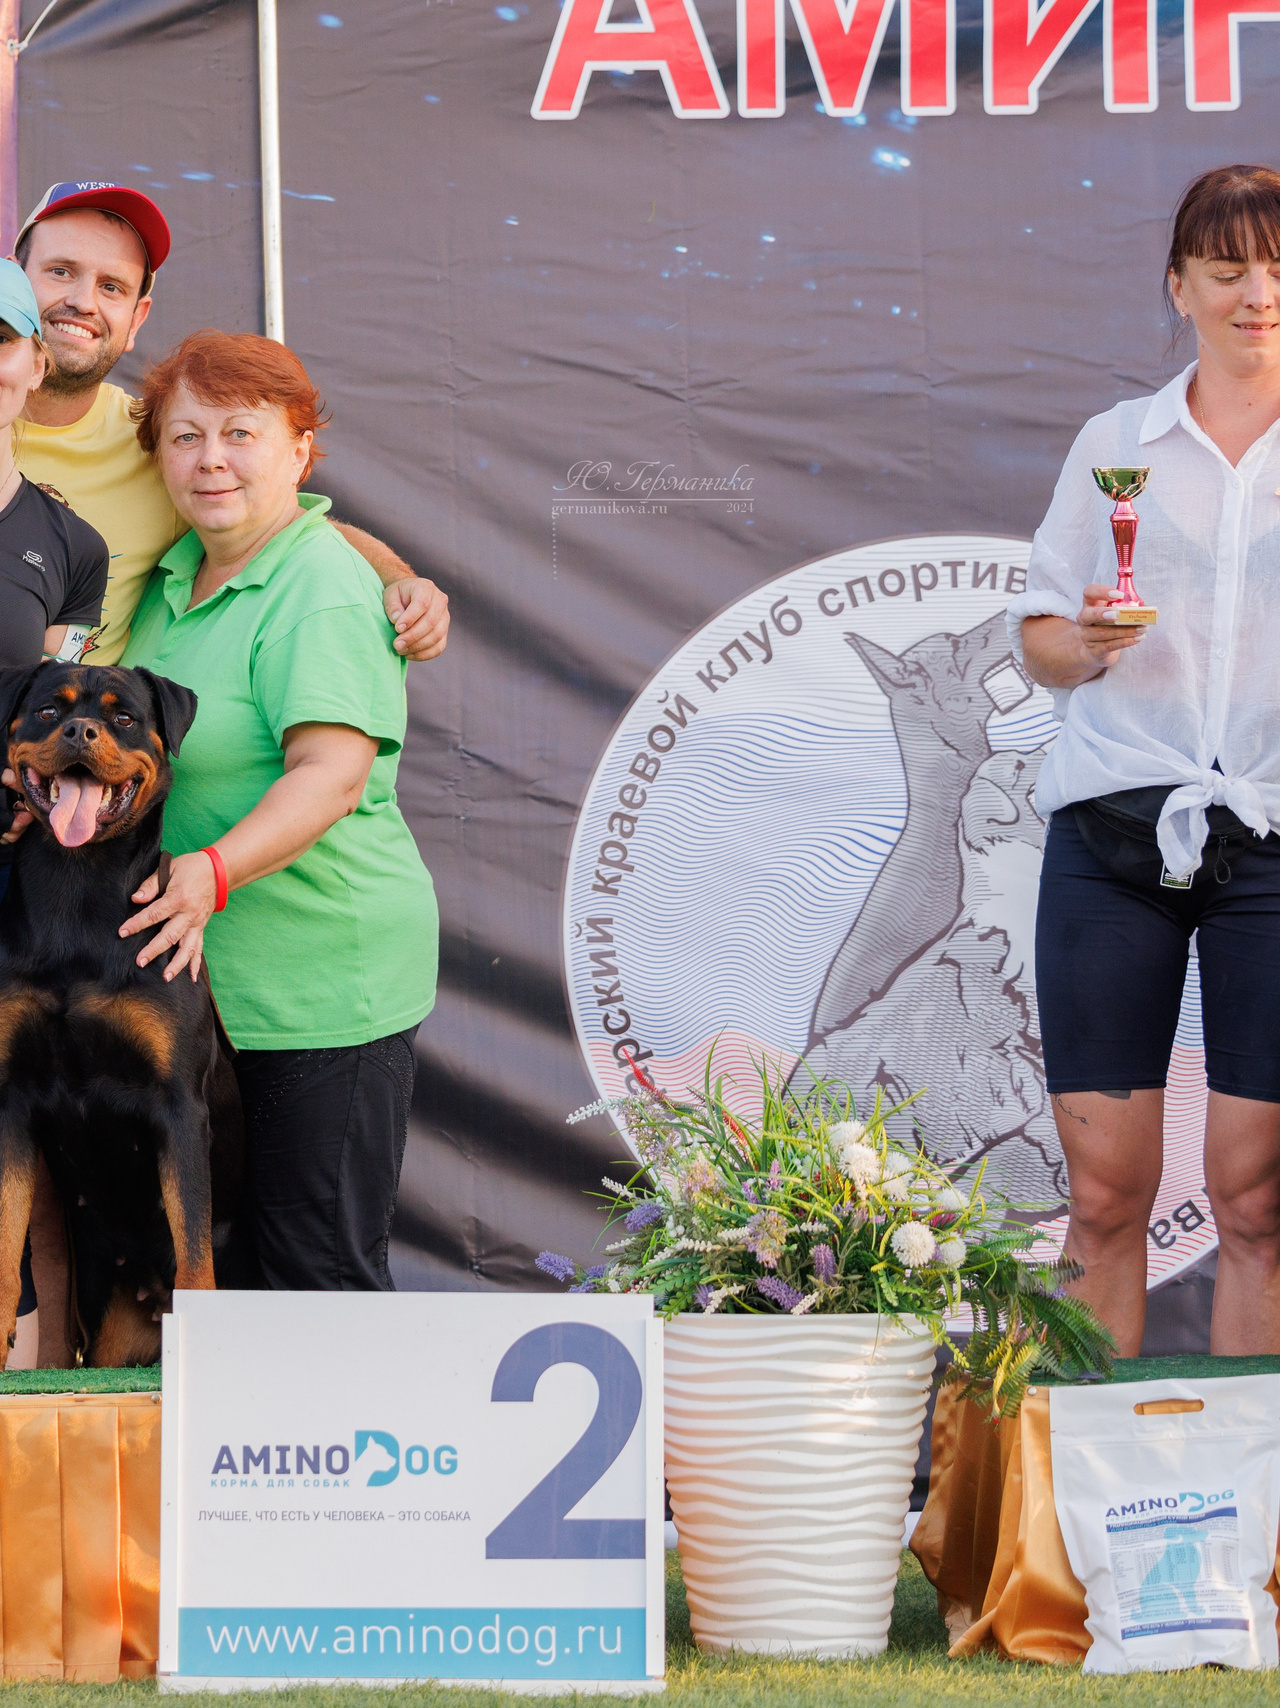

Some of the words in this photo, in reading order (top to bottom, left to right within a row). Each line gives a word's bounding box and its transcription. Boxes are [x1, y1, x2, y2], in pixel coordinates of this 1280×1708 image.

[591, 689, 699, 896] краевой
[695, 595, 804, 694] клуб
[485, 1321, 646, 1560] 2
[211, 1478, 258, 1488] КОРМА
[266, 1478, 295, 1489] ДЛЯ
[303, 1478, 350, 1488] СОБАК
[197, 1510, 252, 1523] ЛУЧШЕЕ,
[255, 1510, 278, 1522] ЧТО
[281, 1510, 311, 1522] ЕСТЬ
[312, 1510, 321, 1522] У
[323, 1510, 386, 1522] ЧЕЛОВЕКА
[397, 1510, 421, 1522] ЭТО
[423, 1510, 472, 1522] СОБАКА
[206, 1613, 623, 1667] www.aminodog.ru
